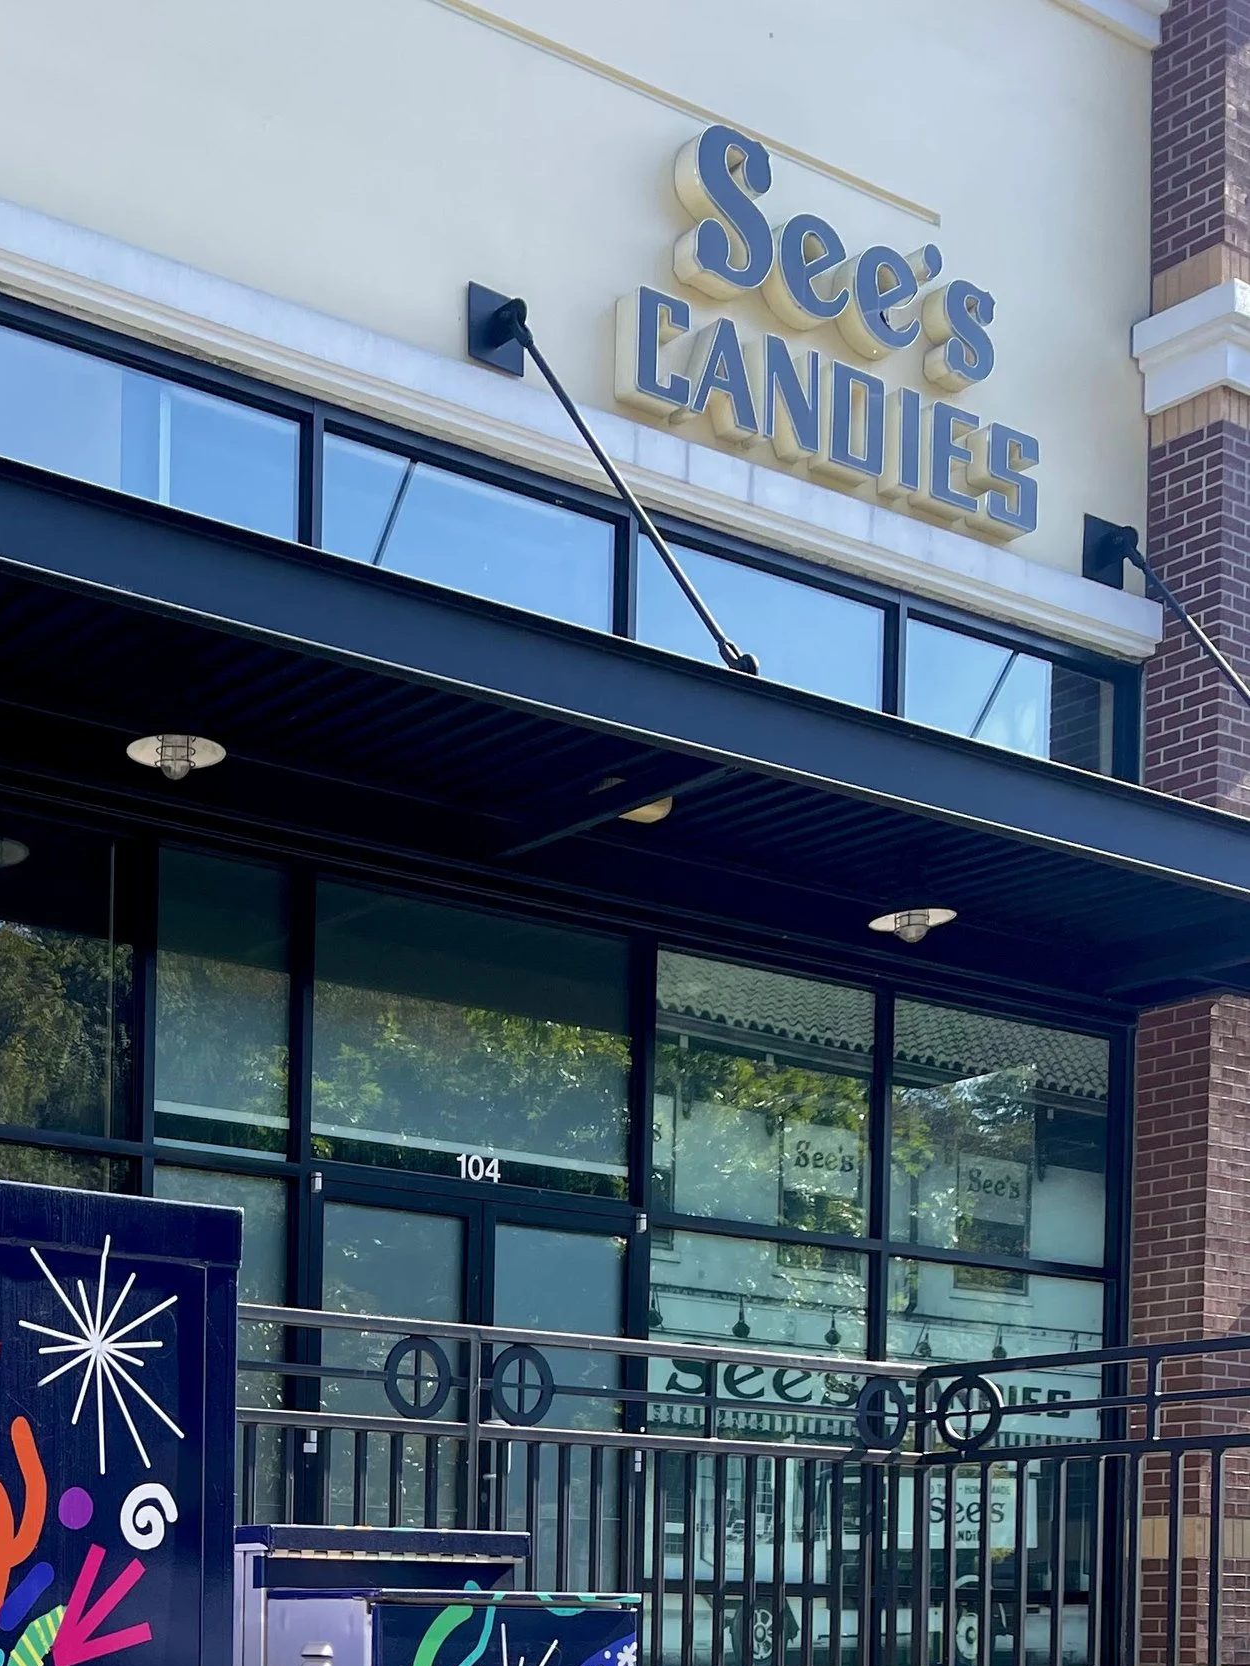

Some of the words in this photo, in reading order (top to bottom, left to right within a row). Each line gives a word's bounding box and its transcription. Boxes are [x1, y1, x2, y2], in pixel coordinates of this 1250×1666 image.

[693, 124, 997, 382] See's
[636, 285, 1040, 534] CANDIES
[456, 1153, 501, 1183] 104
[794, 1140, 854, 1172] See's
[968, 1167, 1021, 1200] See's
[665, 1342, 860, 1406] Sees
[930, 1497, 1006, 1524] Sees
